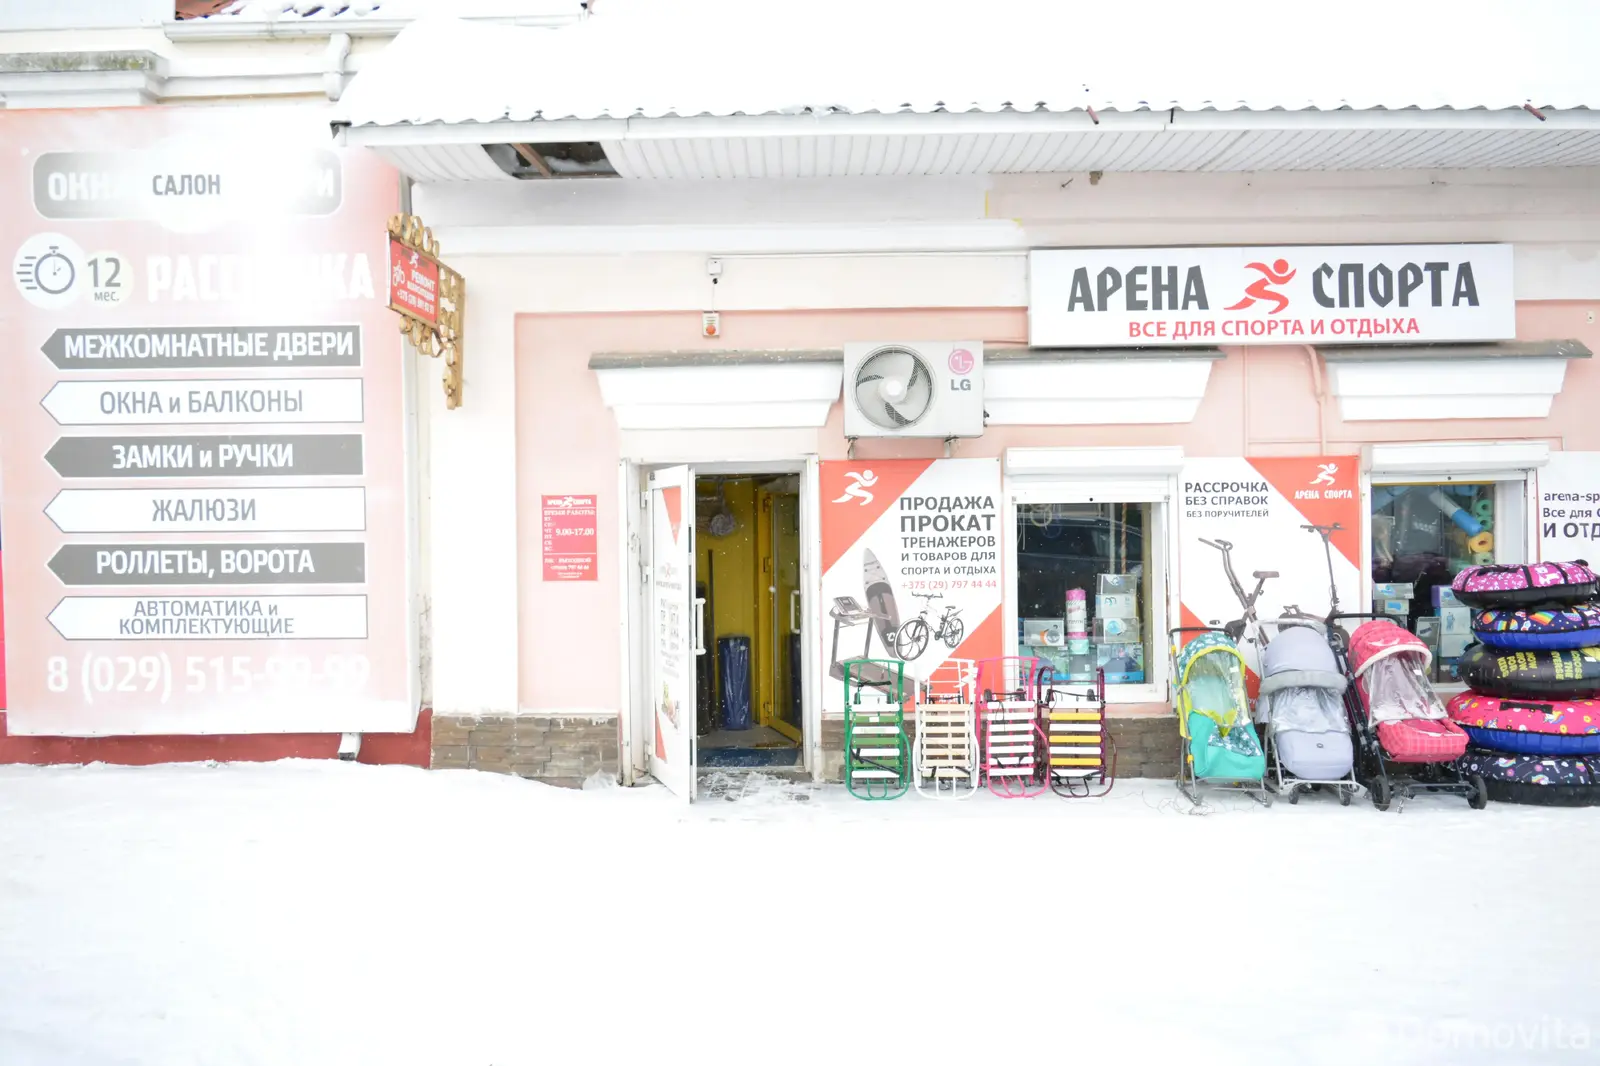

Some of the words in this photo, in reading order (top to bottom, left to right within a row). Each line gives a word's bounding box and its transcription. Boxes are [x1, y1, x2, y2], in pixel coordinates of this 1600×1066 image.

[152, 174, 221, 196] САЛОН
[87, 257, 121, 288] 12
[1067, 265, 1209, 312] АРЕНА
[1312, 261, 1480, 309] СПОРТА
[94, 290, 120, 302] мес.
[1128, 321, 1166, 338] ВСЕ
[1172, 320, 1216, 340] ДЛЯ
[1221, 318, 1304, 337] СПОРТА
[1311, 319, 1325, 335] И
[1331, 316, 1420, 337] ОТДЫХА
[64, 333, 268, 360] МЕЖКОМНАТНЫЕ
[273, 331, 354, 361] ДВЕРИ
[951, 379, 971, 390] LG
[100, 391, 161, 415] ОКНА
[168, 397, 181, 414] и
[188, 389, 303, 413] БАЛКОНЫ
[112, 444, 193, 470] ЗАМКИ
[199, 450, 213, 469] и
[219, 443, 294, 469] РУЧКИ
[1185, 482, 1269, 493] РАССРОЧКА
[1294, 490, 1319, 499] АРЕНА
[1324, 490, 1352, 499] СПОРТА
[900, 496, 994, 512] ПРОДАЖА
[1185, 496, 1207, 505] БЕЗ
[1211, 496, 1268, 505] СПРАВОК
[1544, 493, 1600, 504] arena-sp
[152, 498, 256, 522] ЖАЛЮЗИ
[1186, 510, 1202, 518] БЕЗ
[1205, 509, 1269, 518] ПОРУЧИТЕЛЕЙ
[1543, 508, 1566, 518] Все
[1570, 509, 1592, 519] для
[901, 514, 996, 532] ПРОКАТ
[1544, 523, 1556, 538] И
[901, 536, 996, 548] ТРЕНАЖЕРОВ
[96, 551, 215, 578] РОЛЛЕТЫ,
[220, 549, 315, 574] ВОРОТА
[901, 553, 909, 561] И
[913, 552, 967, 561] ТОВАРОВ
[971, 552, 996, 561] ДЛЯ
[901, 567, 940, 575] СПОРТА
[954, 566, 996, 575] ОТДЫХА
[901, 580, 925, 589] +375
[928, 580, 948, 590] (29)
[951, 580, 968, 588] 797
[971, 580, 982, 588] 44
[985, 580, 997, 588] 44
[134, 600, 264, 617] АВТОМАТИКА
[268, 604, 278, 615] и
[119, 618, 294, 636] КОМПЛЕКТУЮЩИЕ
[47, 655, 68, 692] 8
[81, 650, 172, 703] (029)
